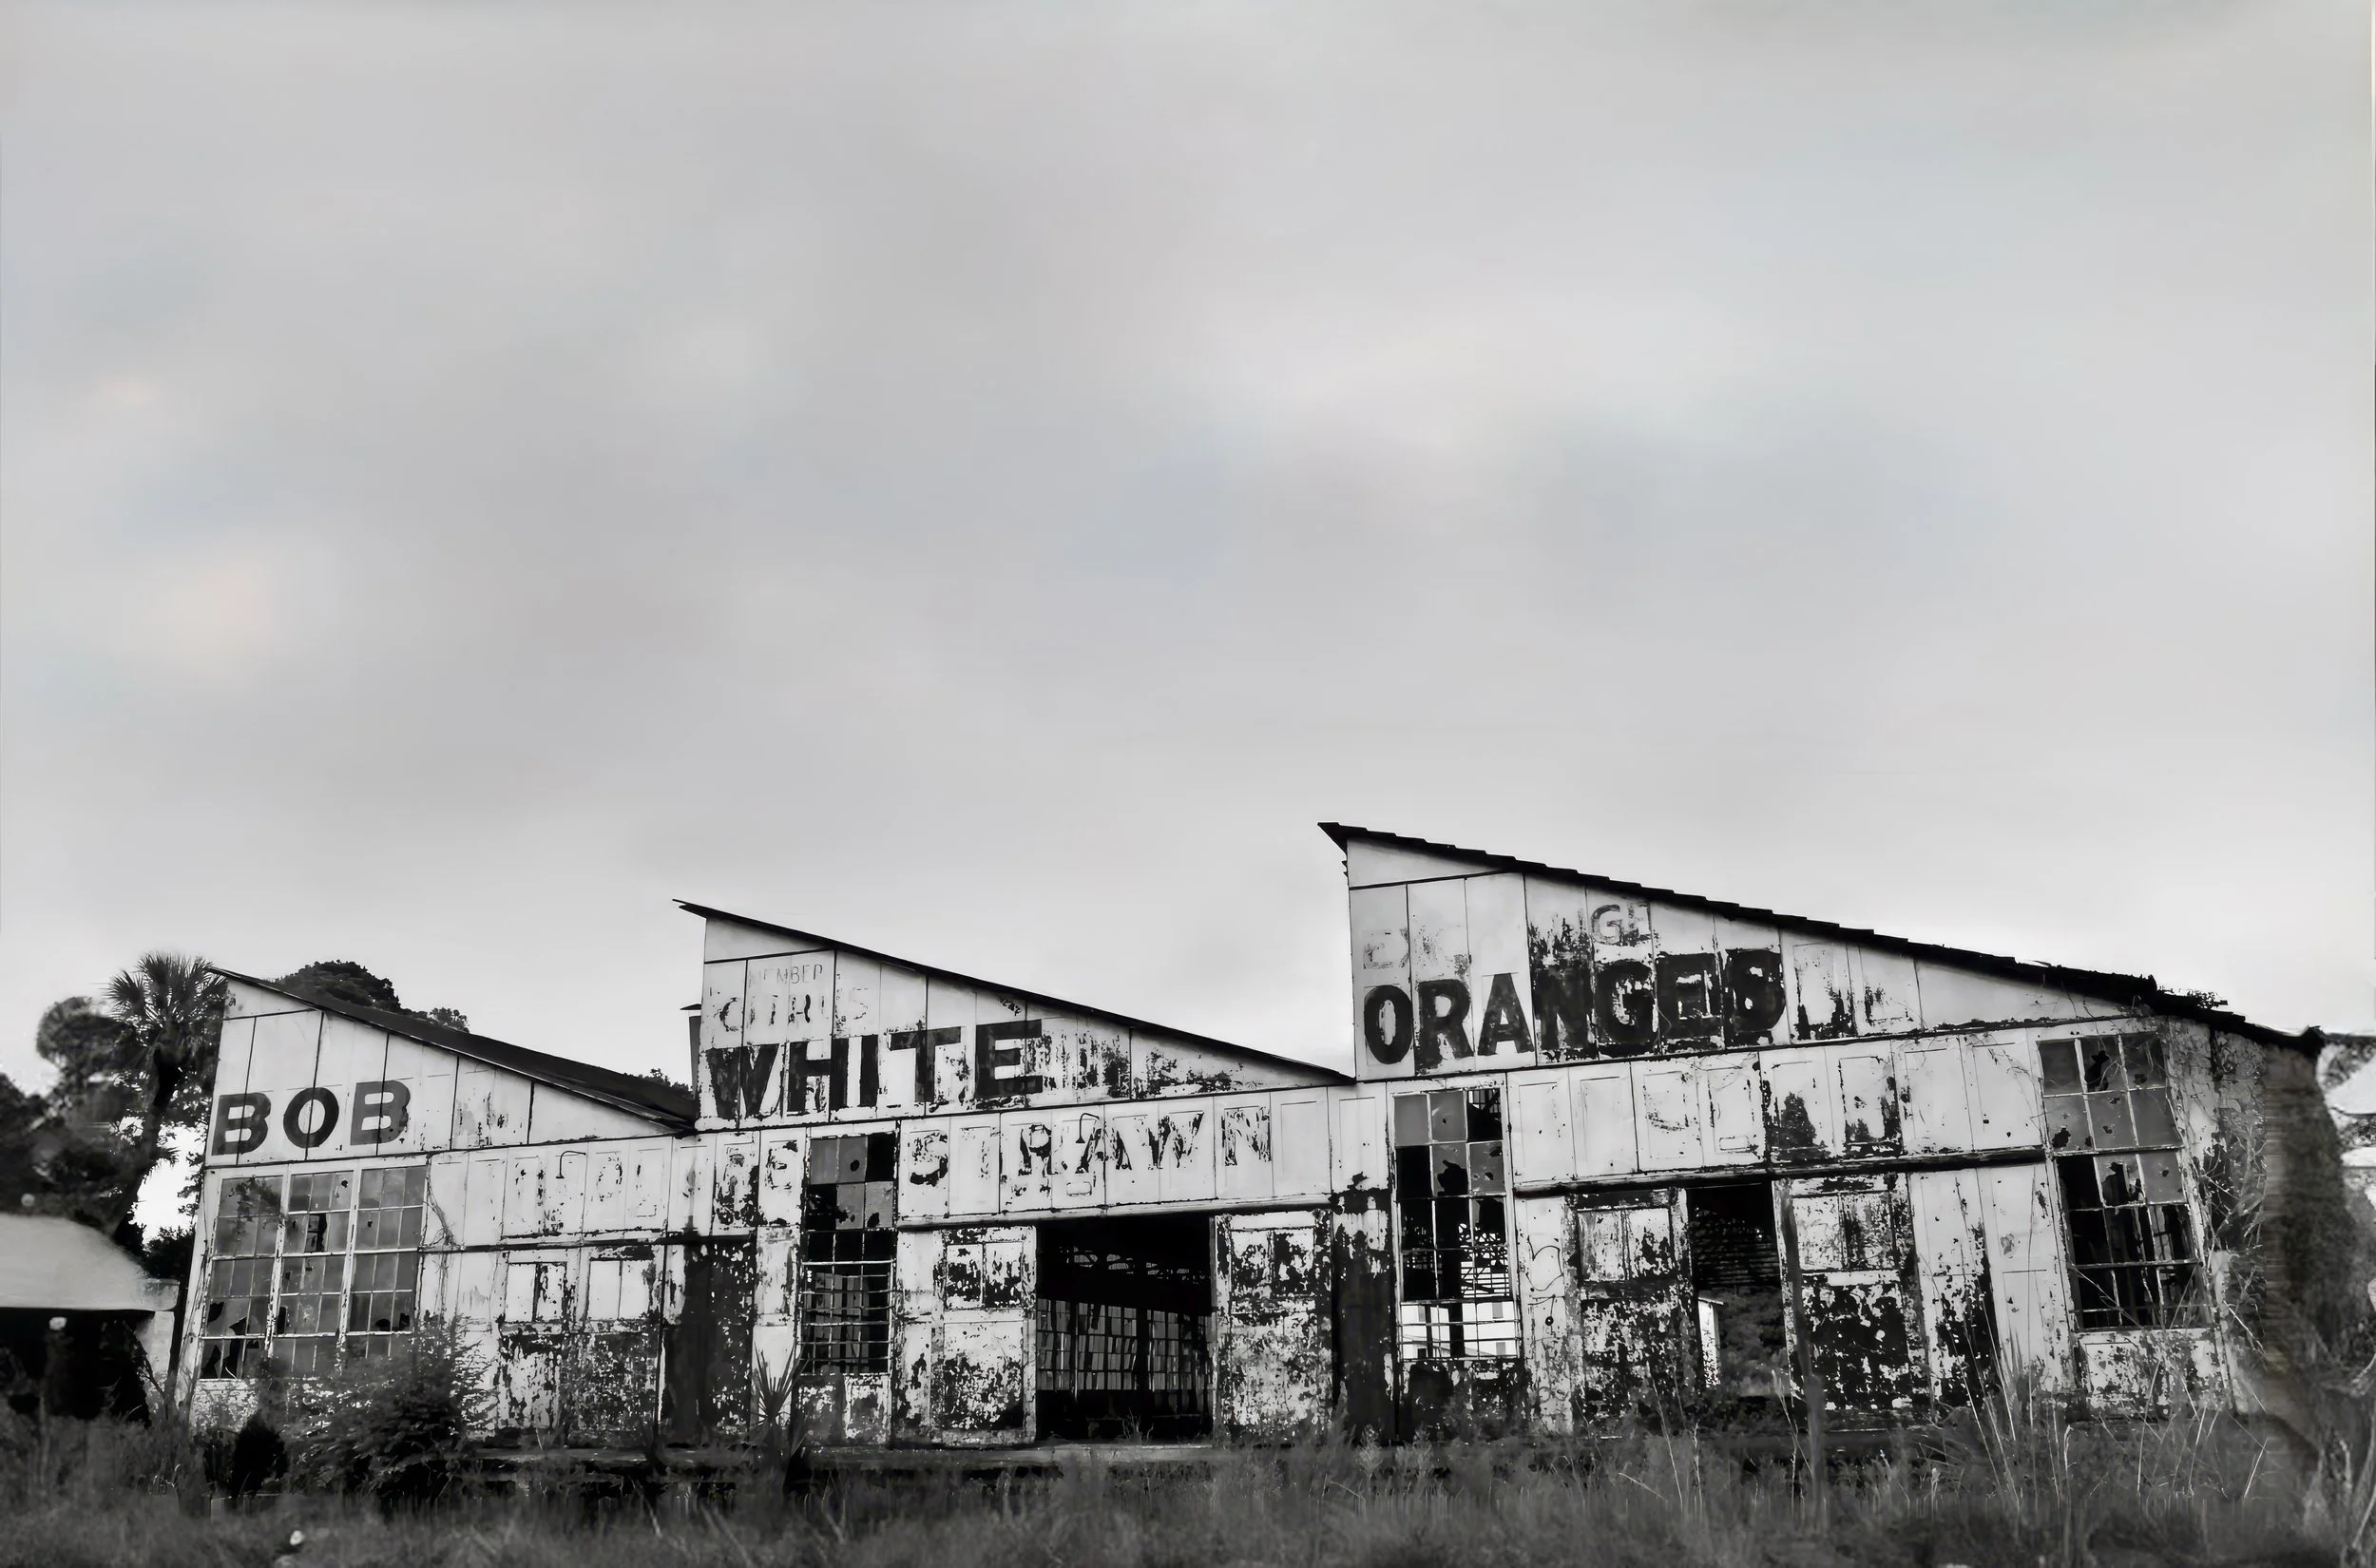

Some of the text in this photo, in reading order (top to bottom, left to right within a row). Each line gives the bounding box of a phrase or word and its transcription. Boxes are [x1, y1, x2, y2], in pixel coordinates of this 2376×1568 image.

[1364, 948, 1787, 1066] ORANGES
[211, 1080, 411, 1156] BOB
[706, 1019, 1043, 1119] WHITE
